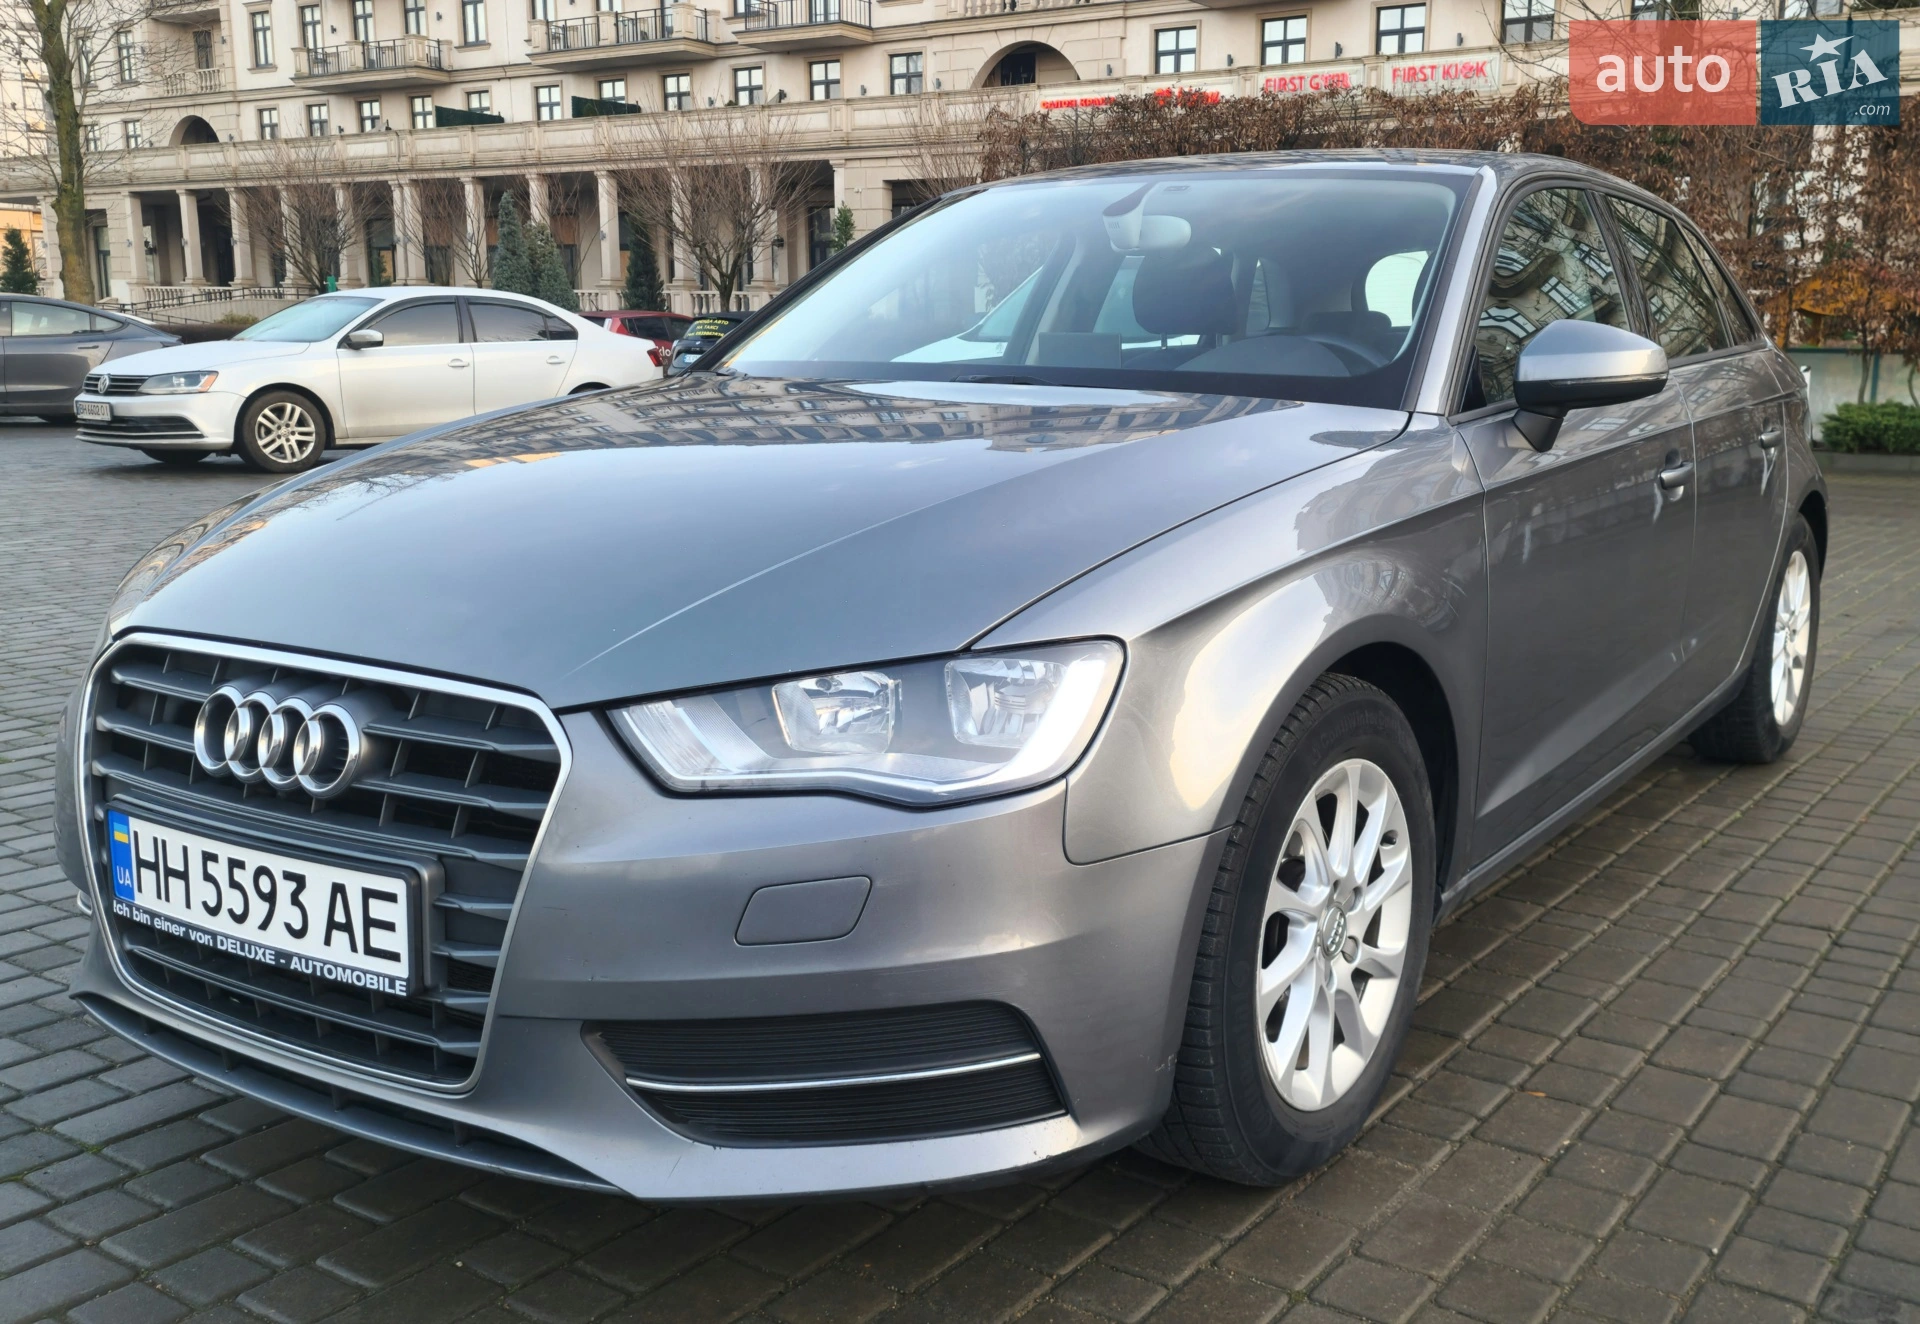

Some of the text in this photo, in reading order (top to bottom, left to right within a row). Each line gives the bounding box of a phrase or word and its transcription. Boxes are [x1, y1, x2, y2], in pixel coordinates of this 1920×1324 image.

[1264, 76, 1307, 93] FIRST
[1392, 65, 1438, 83] FIRST
[116, 866, 132, 888] UA
[133, 830, 401, 963] HH 5593 AE
[113, 899, 130, 918] Ich
[132, 907, 151, 926] bin
[153, 917, 186, 937] einer
[189, 929, 213, 947] von
[217, 935, 276, 965] DELUXE
[290, 956, 407, 997] AUTOMOBILE
